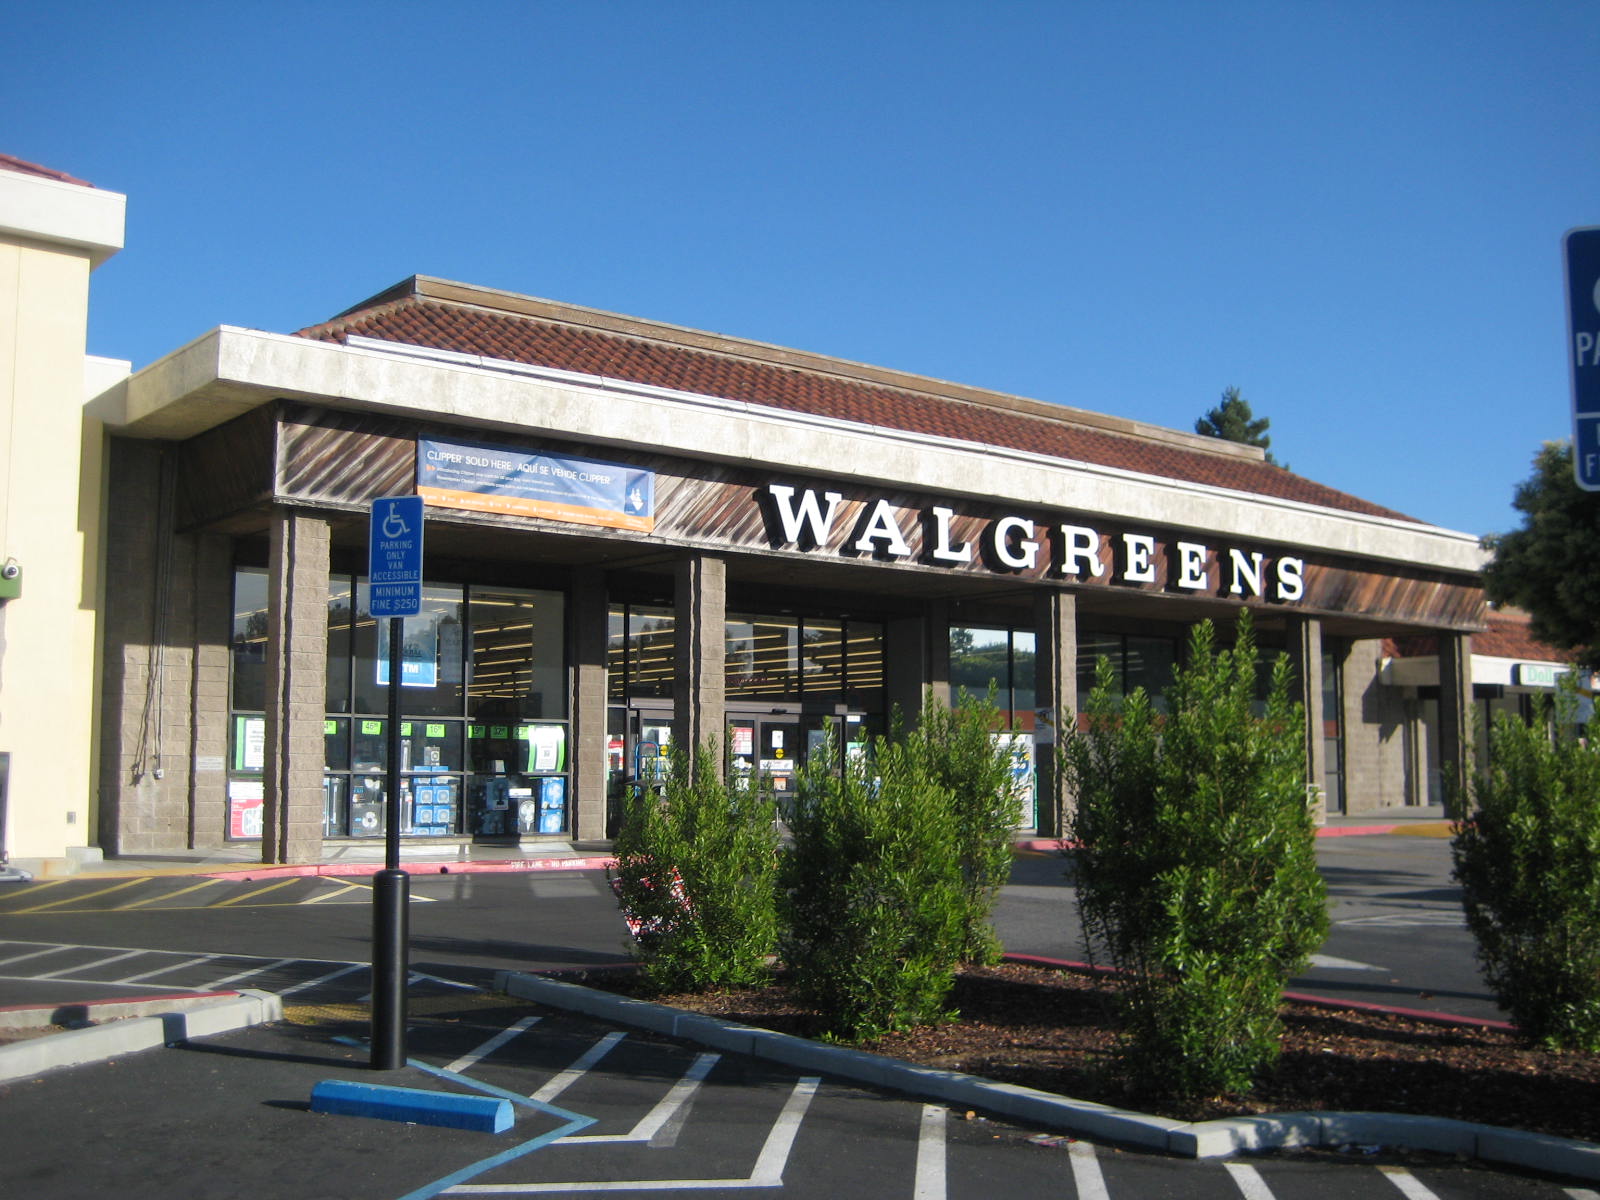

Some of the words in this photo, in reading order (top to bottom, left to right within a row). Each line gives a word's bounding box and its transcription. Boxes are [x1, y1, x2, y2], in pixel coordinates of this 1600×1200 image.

[427, 450, 462, 464] CLIPPER
[465, 455, 489, 467] SOLD
[490, 459, 514, 471] HERE.
[517, 462, 538, 474] AQUÍ
[540, 465, 549, 475] SE
[551, 467, 577, 480] VENDE
[579, 472, 611, 485] CLIPPER
[380, 540, 413, 550] PARKING
[769, 484, 1304, 601] WALGREENS
[386, 551, 406, 560] ONLY
[387, 561, 403, 570] VAN
[372, 570, 418, 581] ACCESSIBLE
[375, 586, 414, 597] MINIMUM
[371, 599, 391, 610] FINE
[393, 598, 418, 611] $250
[402, 663, 419, 673] TM
